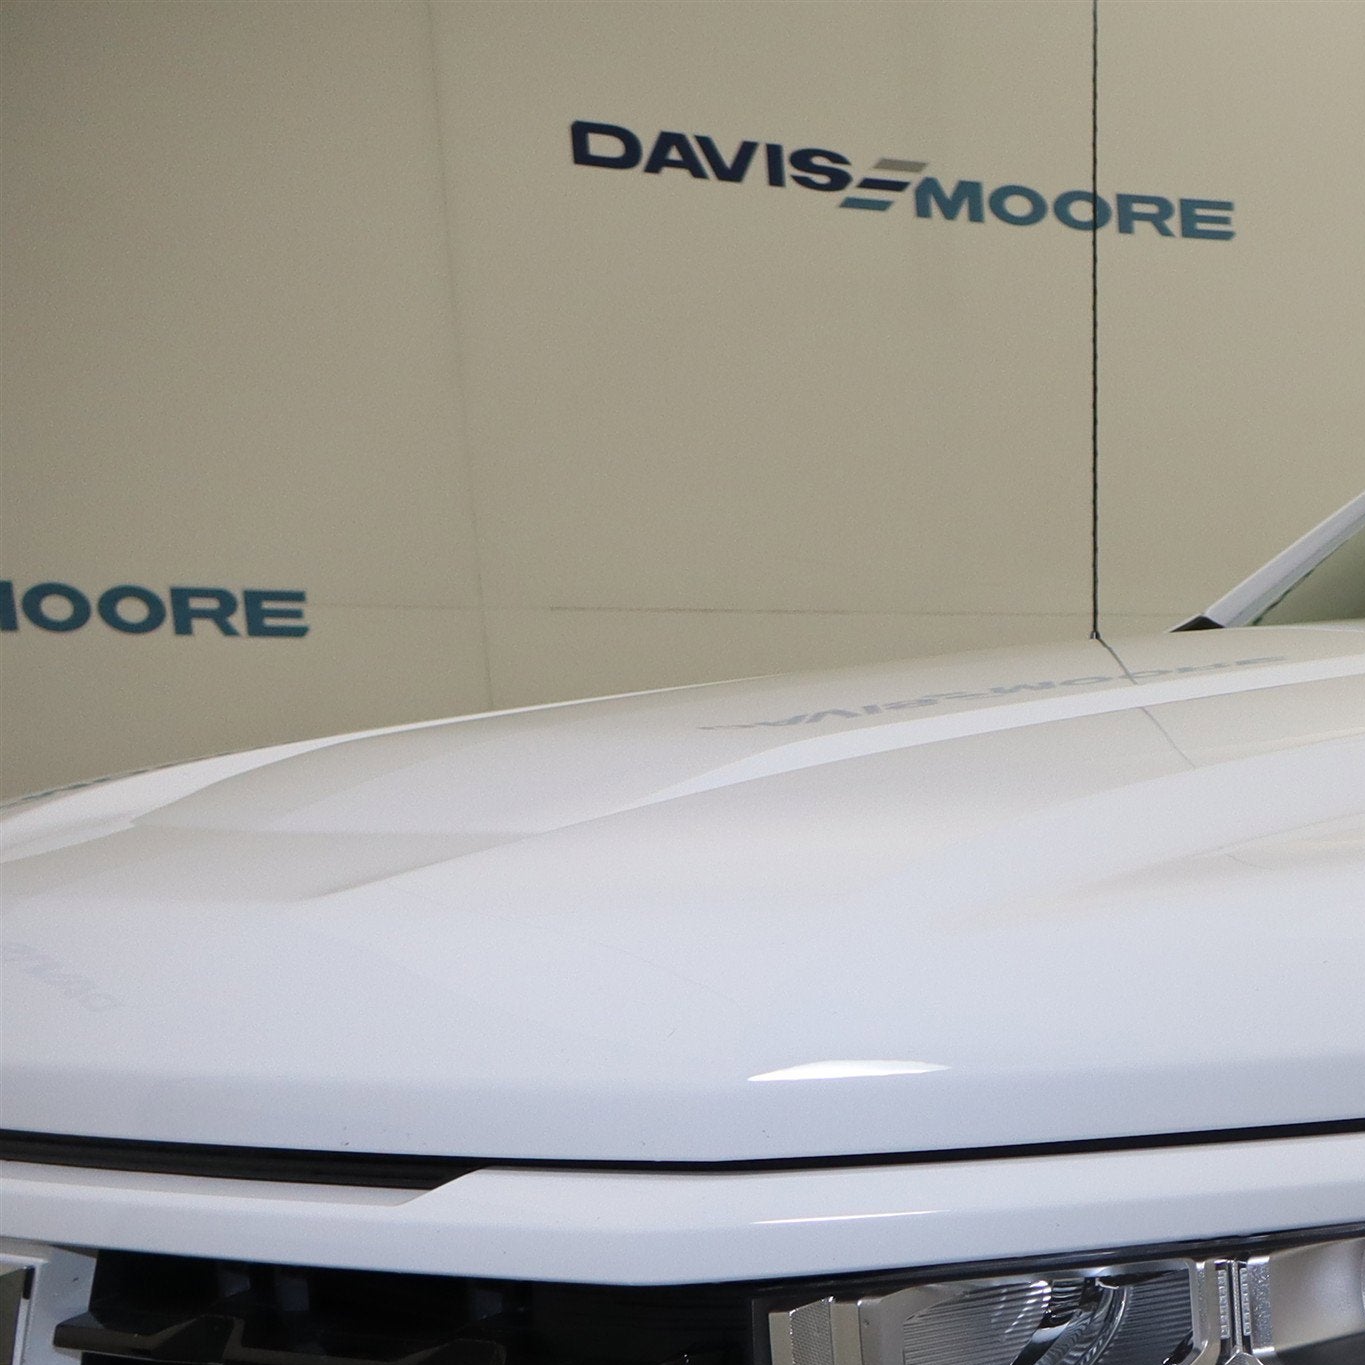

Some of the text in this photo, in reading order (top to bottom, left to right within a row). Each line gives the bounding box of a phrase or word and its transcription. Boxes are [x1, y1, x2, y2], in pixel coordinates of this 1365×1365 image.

[571, 120, 1236, 241] DAVIS MOORE
[0, 580, 310, 638] OORE
